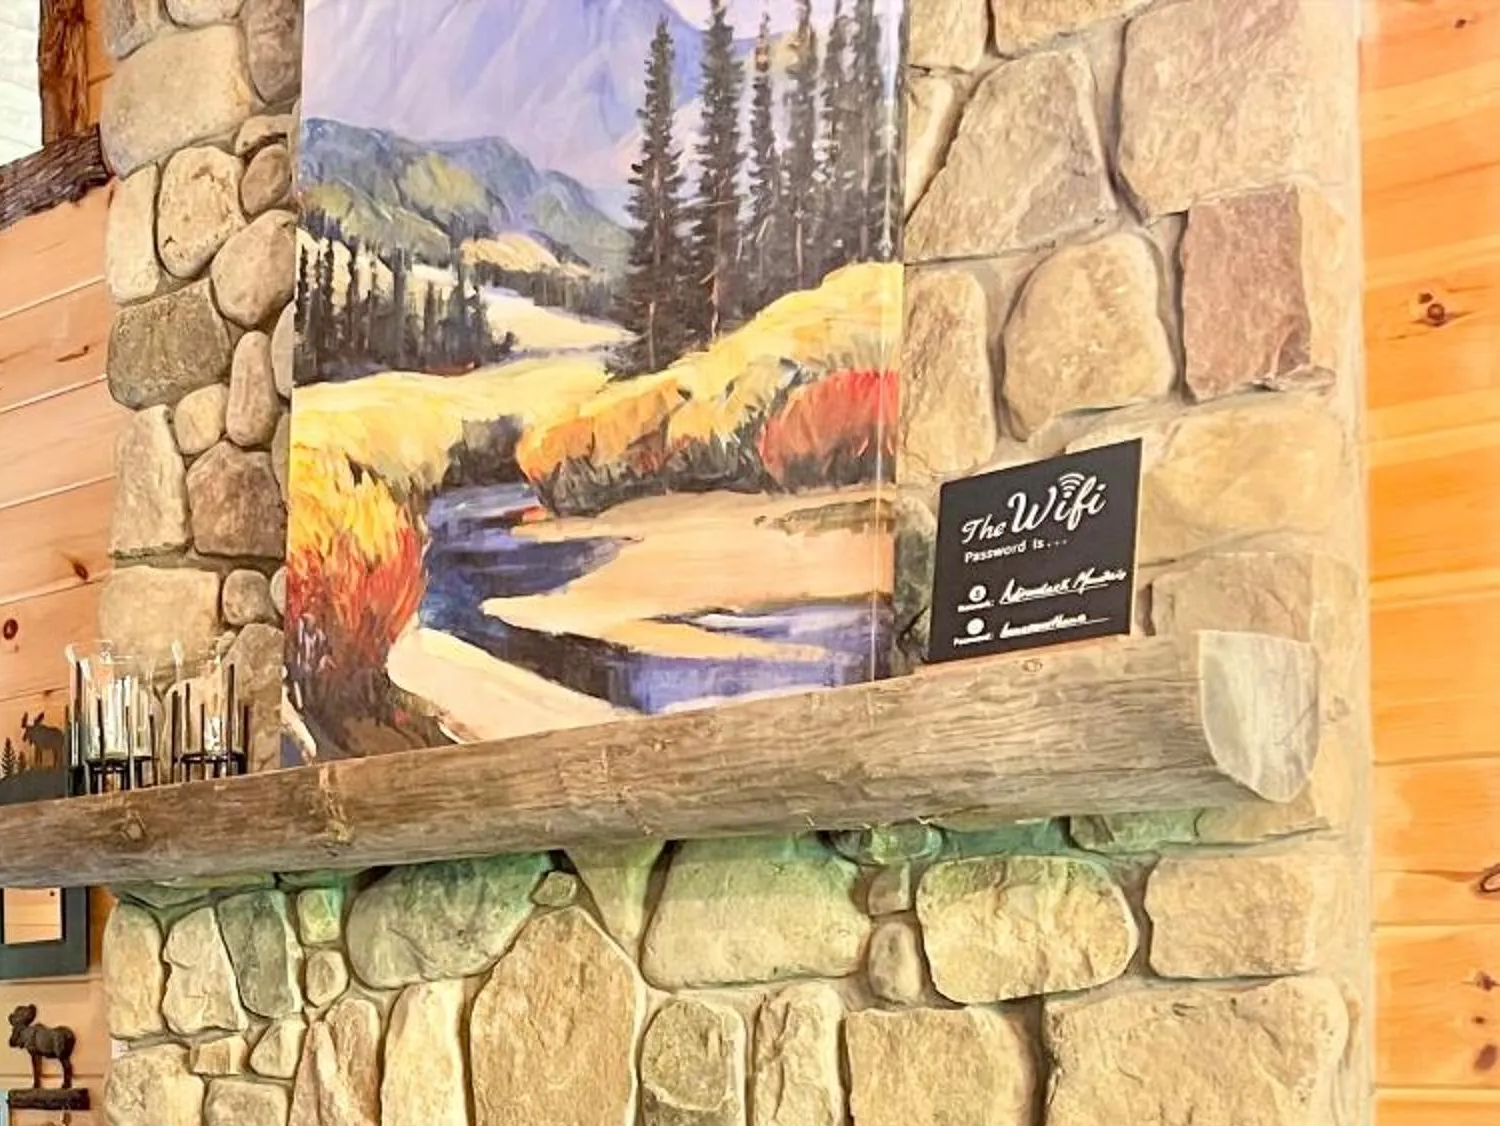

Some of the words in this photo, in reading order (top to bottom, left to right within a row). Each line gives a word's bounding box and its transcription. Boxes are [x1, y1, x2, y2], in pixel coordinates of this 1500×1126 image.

[961, 513, 1006, 545] The
[1007, 474, 1107, 531] Wifi
[964, 540, 1027, 564] Password
